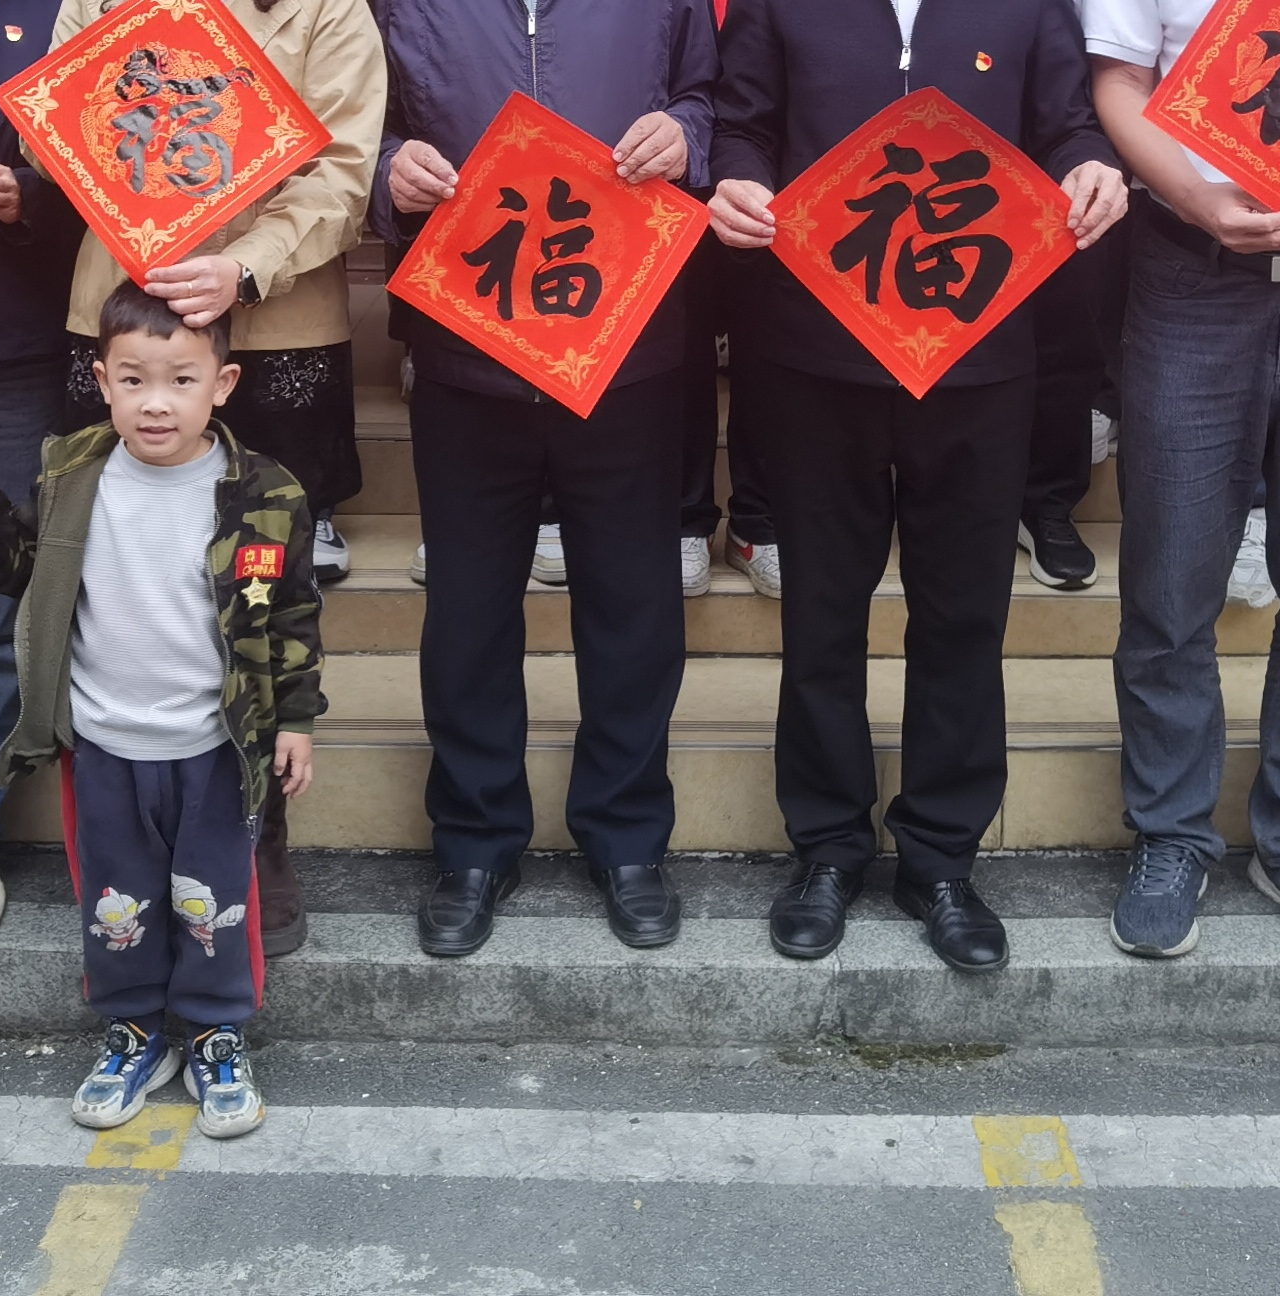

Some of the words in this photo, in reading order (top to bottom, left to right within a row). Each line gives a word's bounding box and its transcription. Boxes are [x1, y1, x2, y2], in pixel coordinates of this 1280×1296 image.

[460, 176, 603, 322] 福
[828, 142, 1014, 325] 福
[242, 564, 277, 576] CHINA
